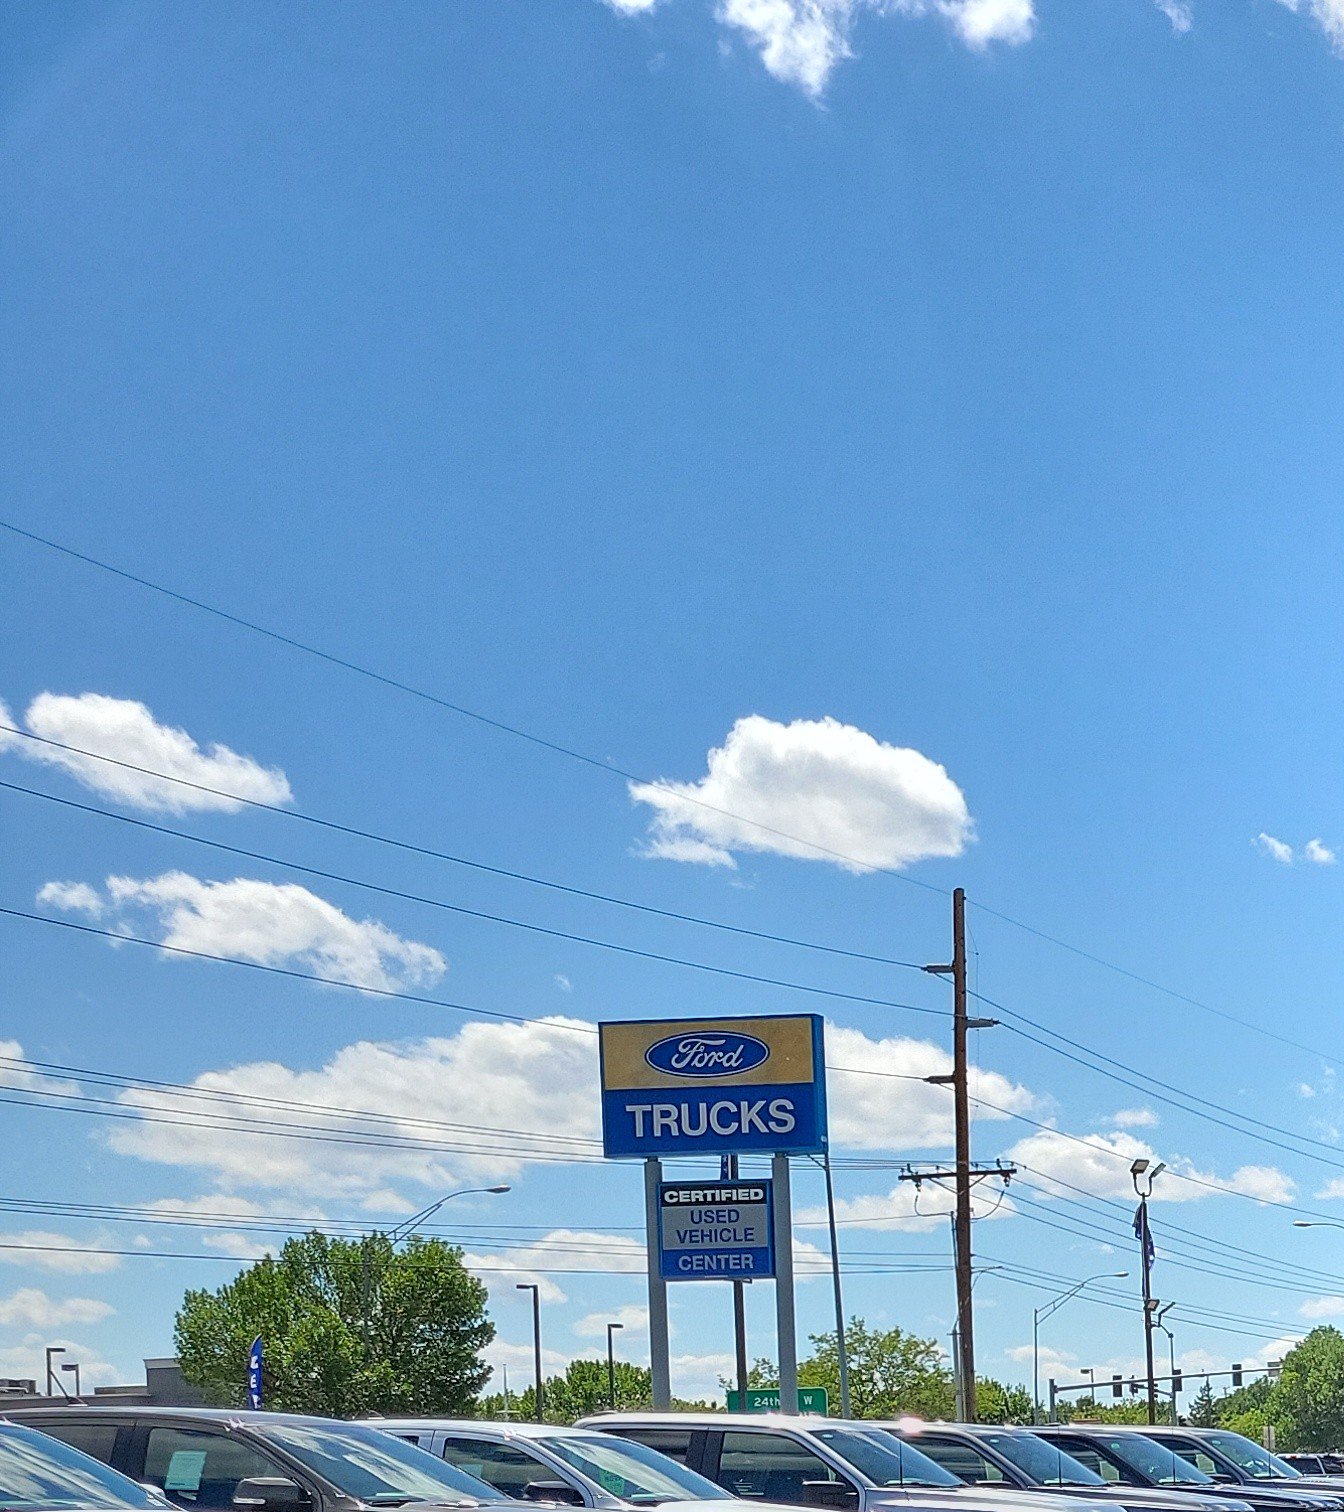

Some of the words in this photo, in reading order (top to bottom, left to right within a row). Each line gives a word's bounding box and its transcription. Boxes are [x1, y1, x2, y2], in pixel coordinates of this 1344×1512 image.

[670, 1038, 746, 1069] Ford
[625, 1098, 796, 1138] TRUCKS
[663, 1188, 764, 1203] CERTIFIED
[690, 1208, 740, 1225] USED
[676, 1226, 755, 1244] VEHICLE
[677, 1253, 754, 1271] CENTER
[753, 1396, 781, 1407] 24th
[803, 1395, 813, 1405] W
